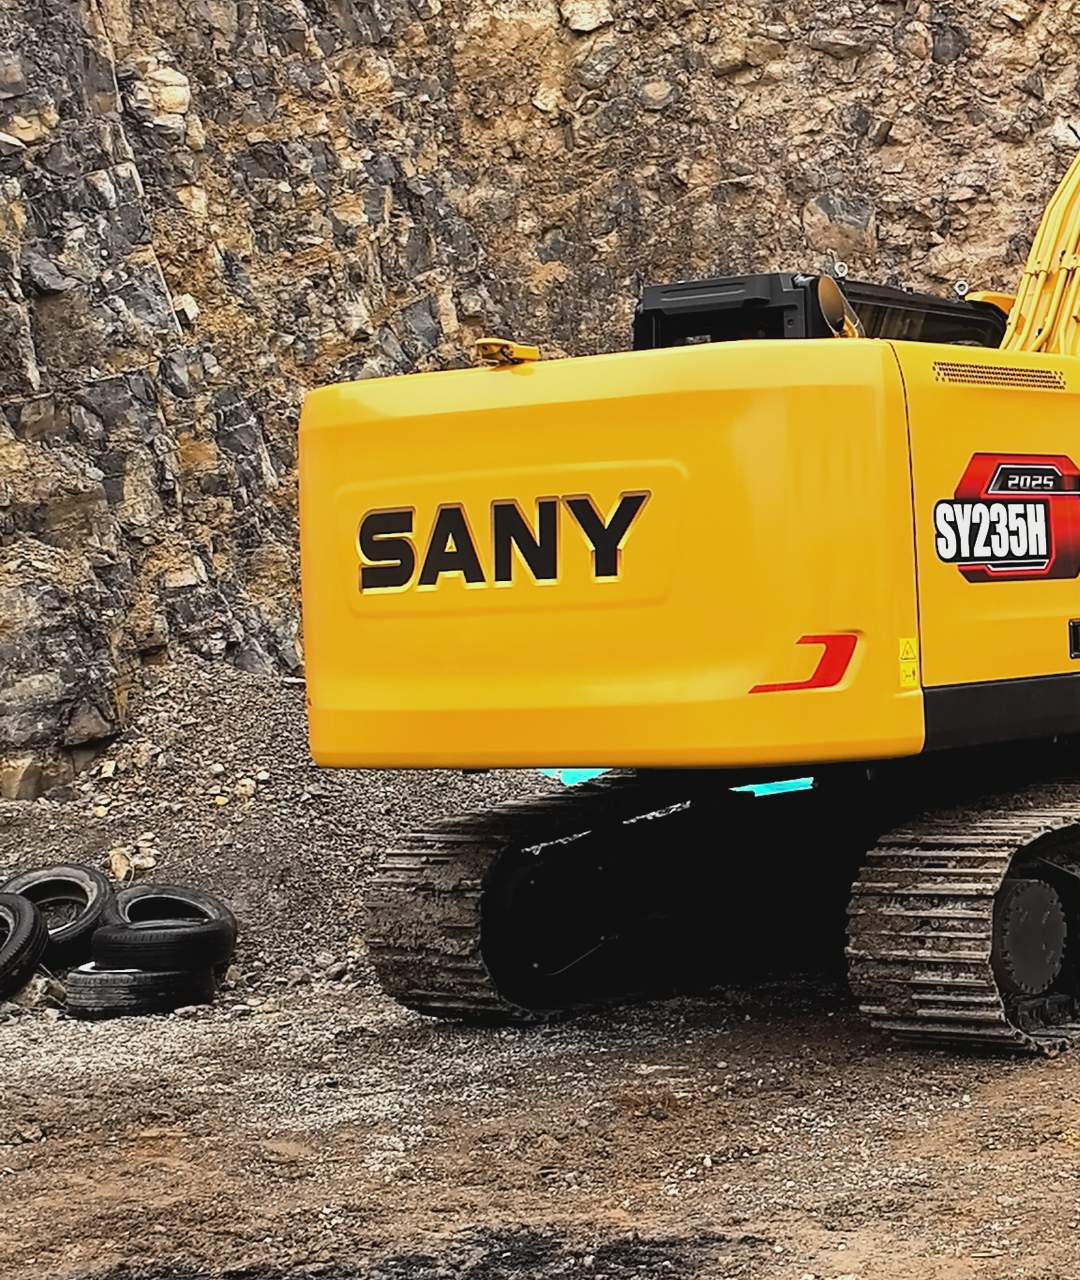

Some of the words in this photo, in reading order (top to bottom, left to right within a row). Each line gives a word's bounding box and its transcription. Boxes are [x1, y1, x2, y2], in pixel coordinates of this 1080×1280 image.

[1007, 475, 1054, 490] 2025
[358, 492, 651, 593] SANY
[935, 502, 1048, 560] SY235H
